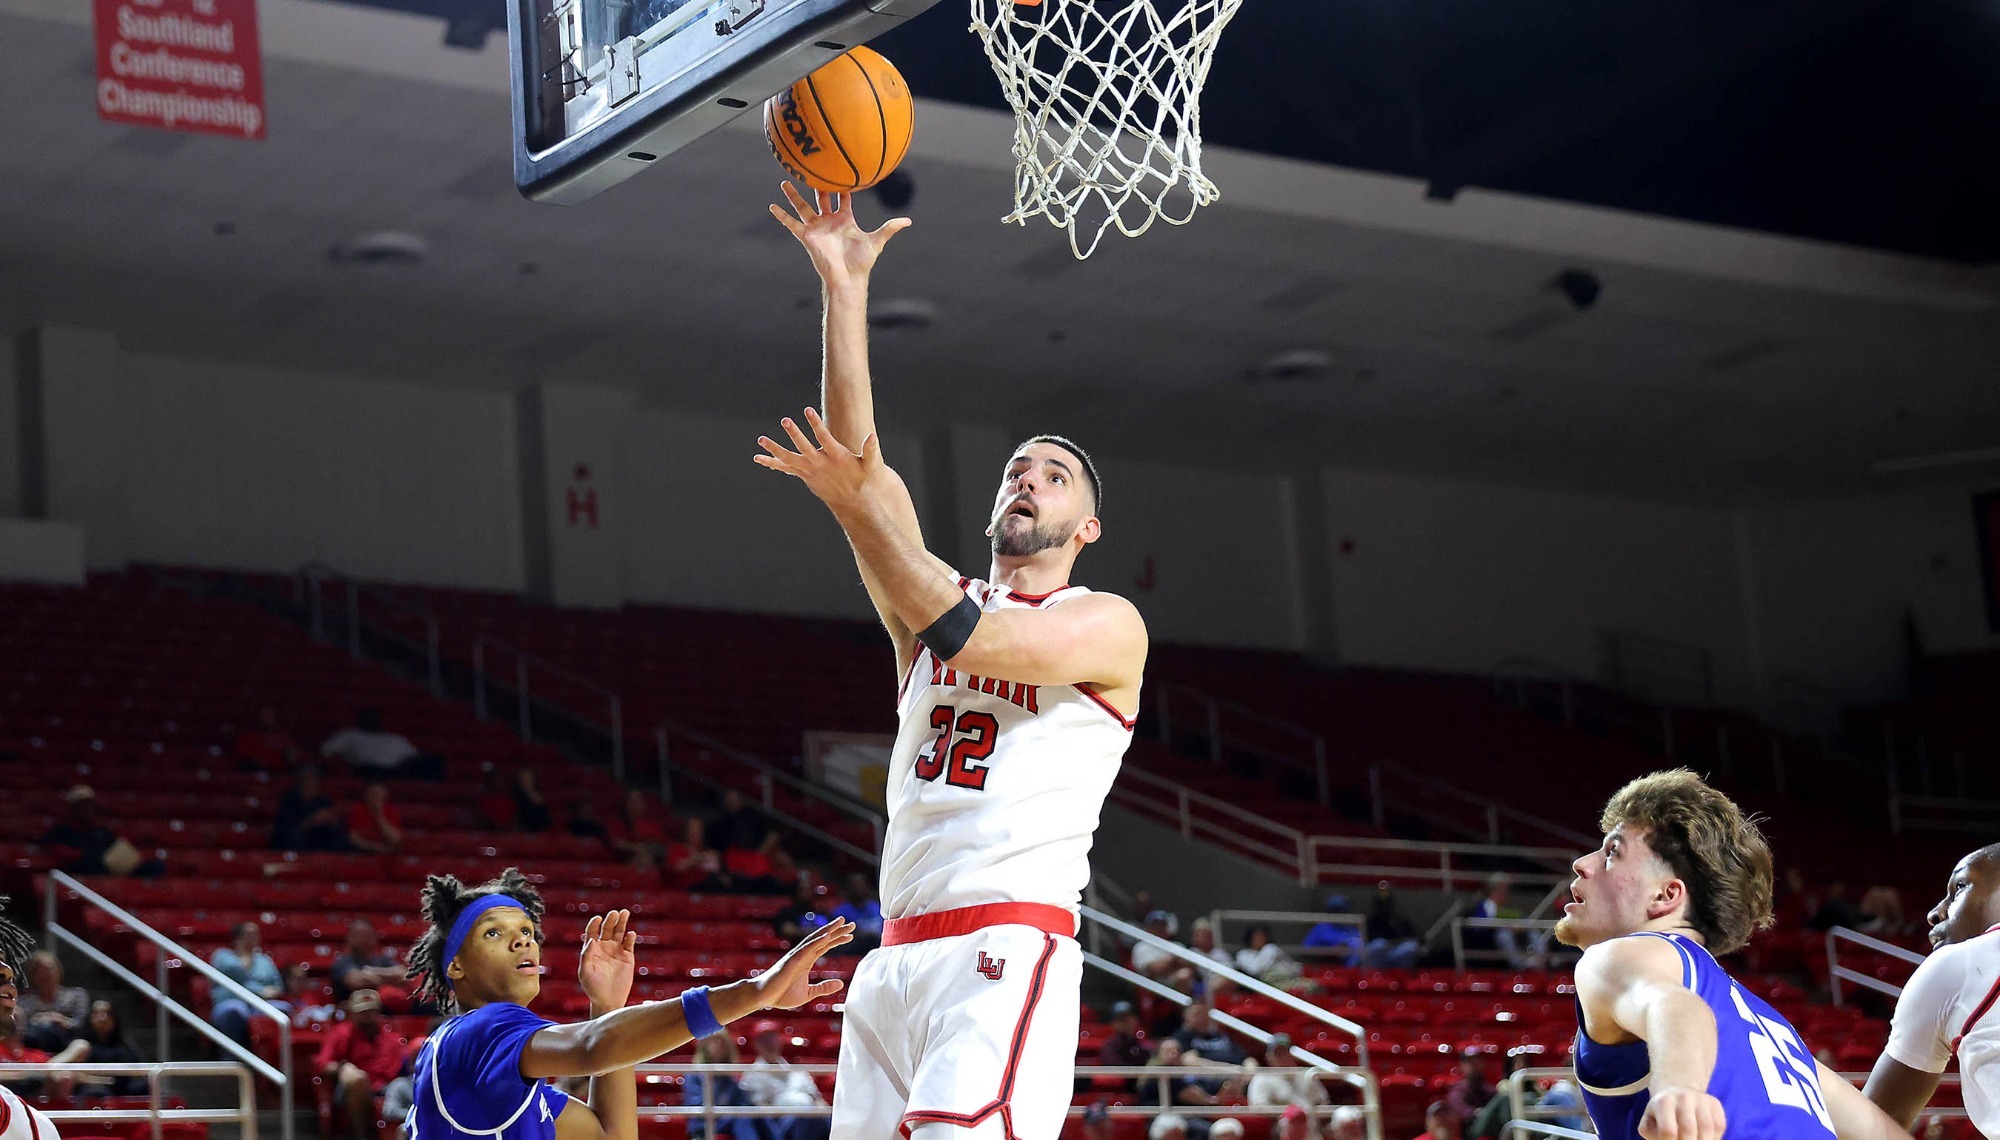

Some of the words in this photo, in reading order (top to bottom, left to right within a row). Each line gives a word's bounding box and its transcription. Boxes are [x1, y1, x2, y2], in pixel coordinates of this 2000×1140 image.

[117, 4, 234, 52] Southland
[110, 40, 245, 91] Conference
[98, 77, 262, 136] Championship
[565, 487, 598, 529] H
[915, 704, 1000, 791] 32
[976, 951, 1006, 980] LU
[1729, 984, 1838, 1139] 25
